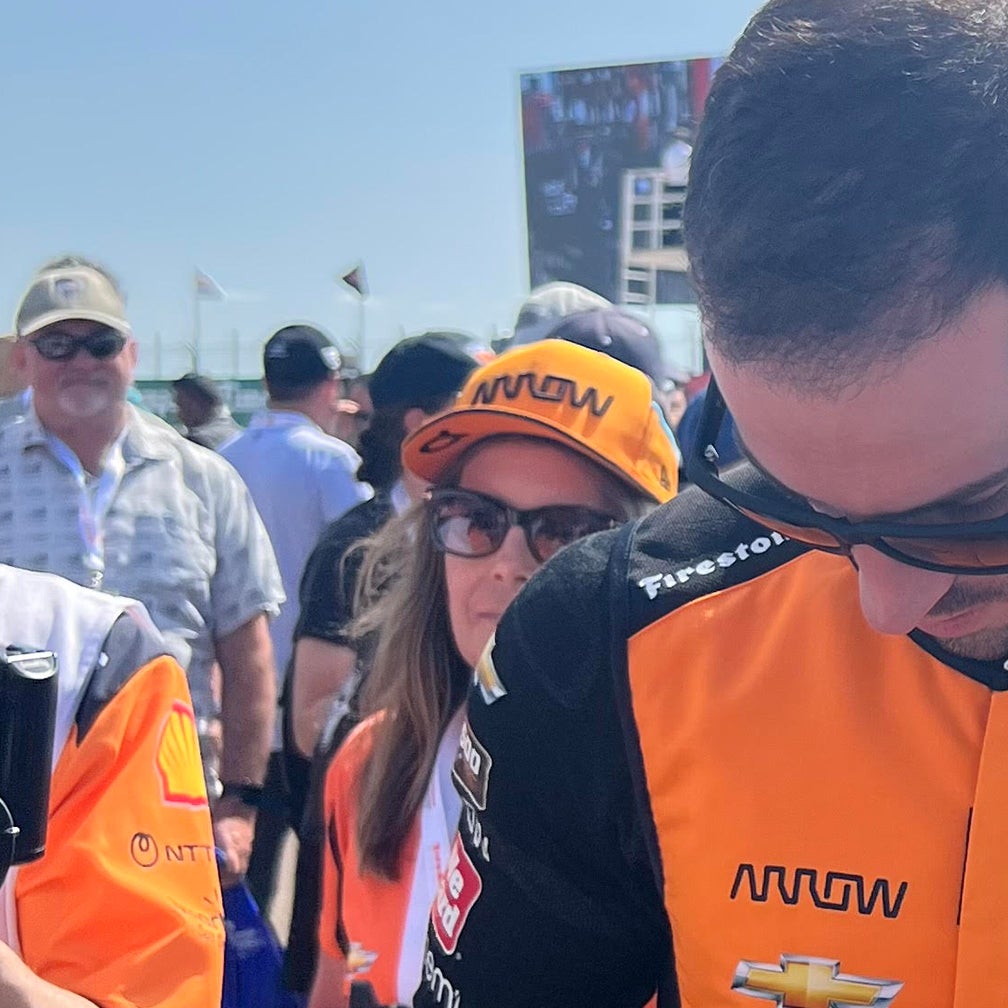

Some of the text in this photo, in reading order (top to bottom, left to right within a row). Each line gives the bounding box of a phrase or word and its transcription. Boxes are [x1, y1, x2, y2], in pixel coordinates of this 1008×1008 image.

[470, 373, 614, 417] ARROW
[638, 531, 791, 600] Firesto
[165, 844, 212, 862] NTT
[731, 864, 908, 919] ARROW
